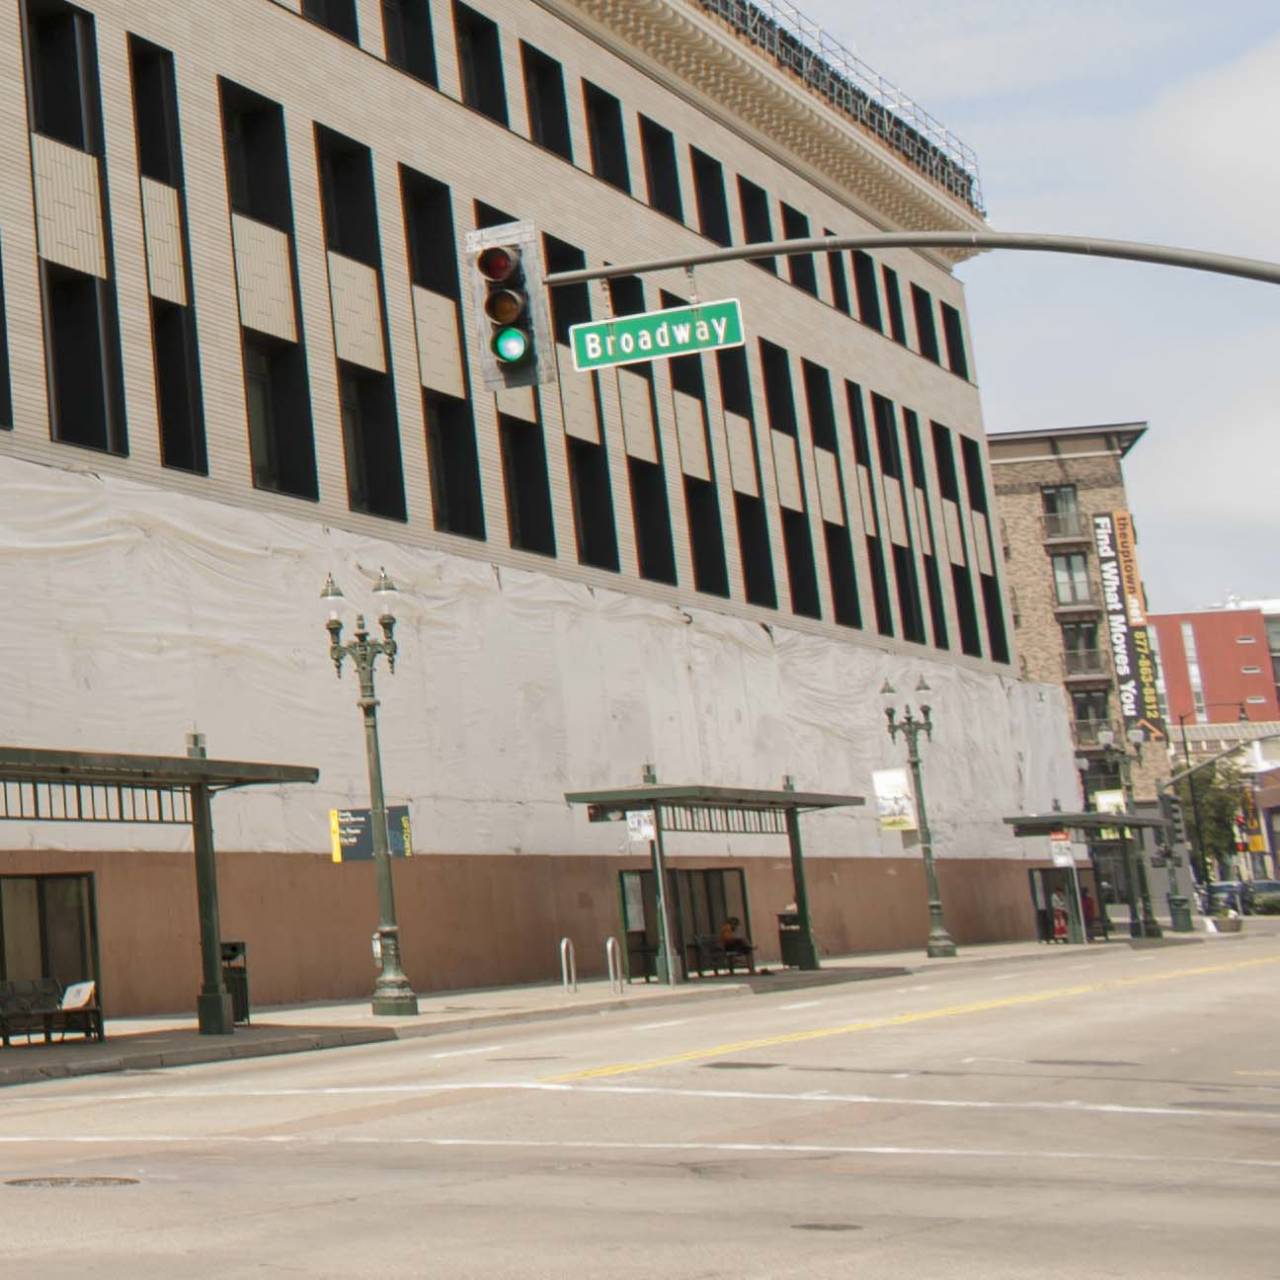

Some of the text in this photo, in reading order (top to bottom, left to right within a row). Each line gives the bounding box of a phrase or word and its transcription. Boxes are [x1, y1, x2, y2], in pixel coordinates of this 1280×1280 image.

[584, 317, 727, 359] Broadway
[1094, 516, 1138, 717] Find What Moves You
